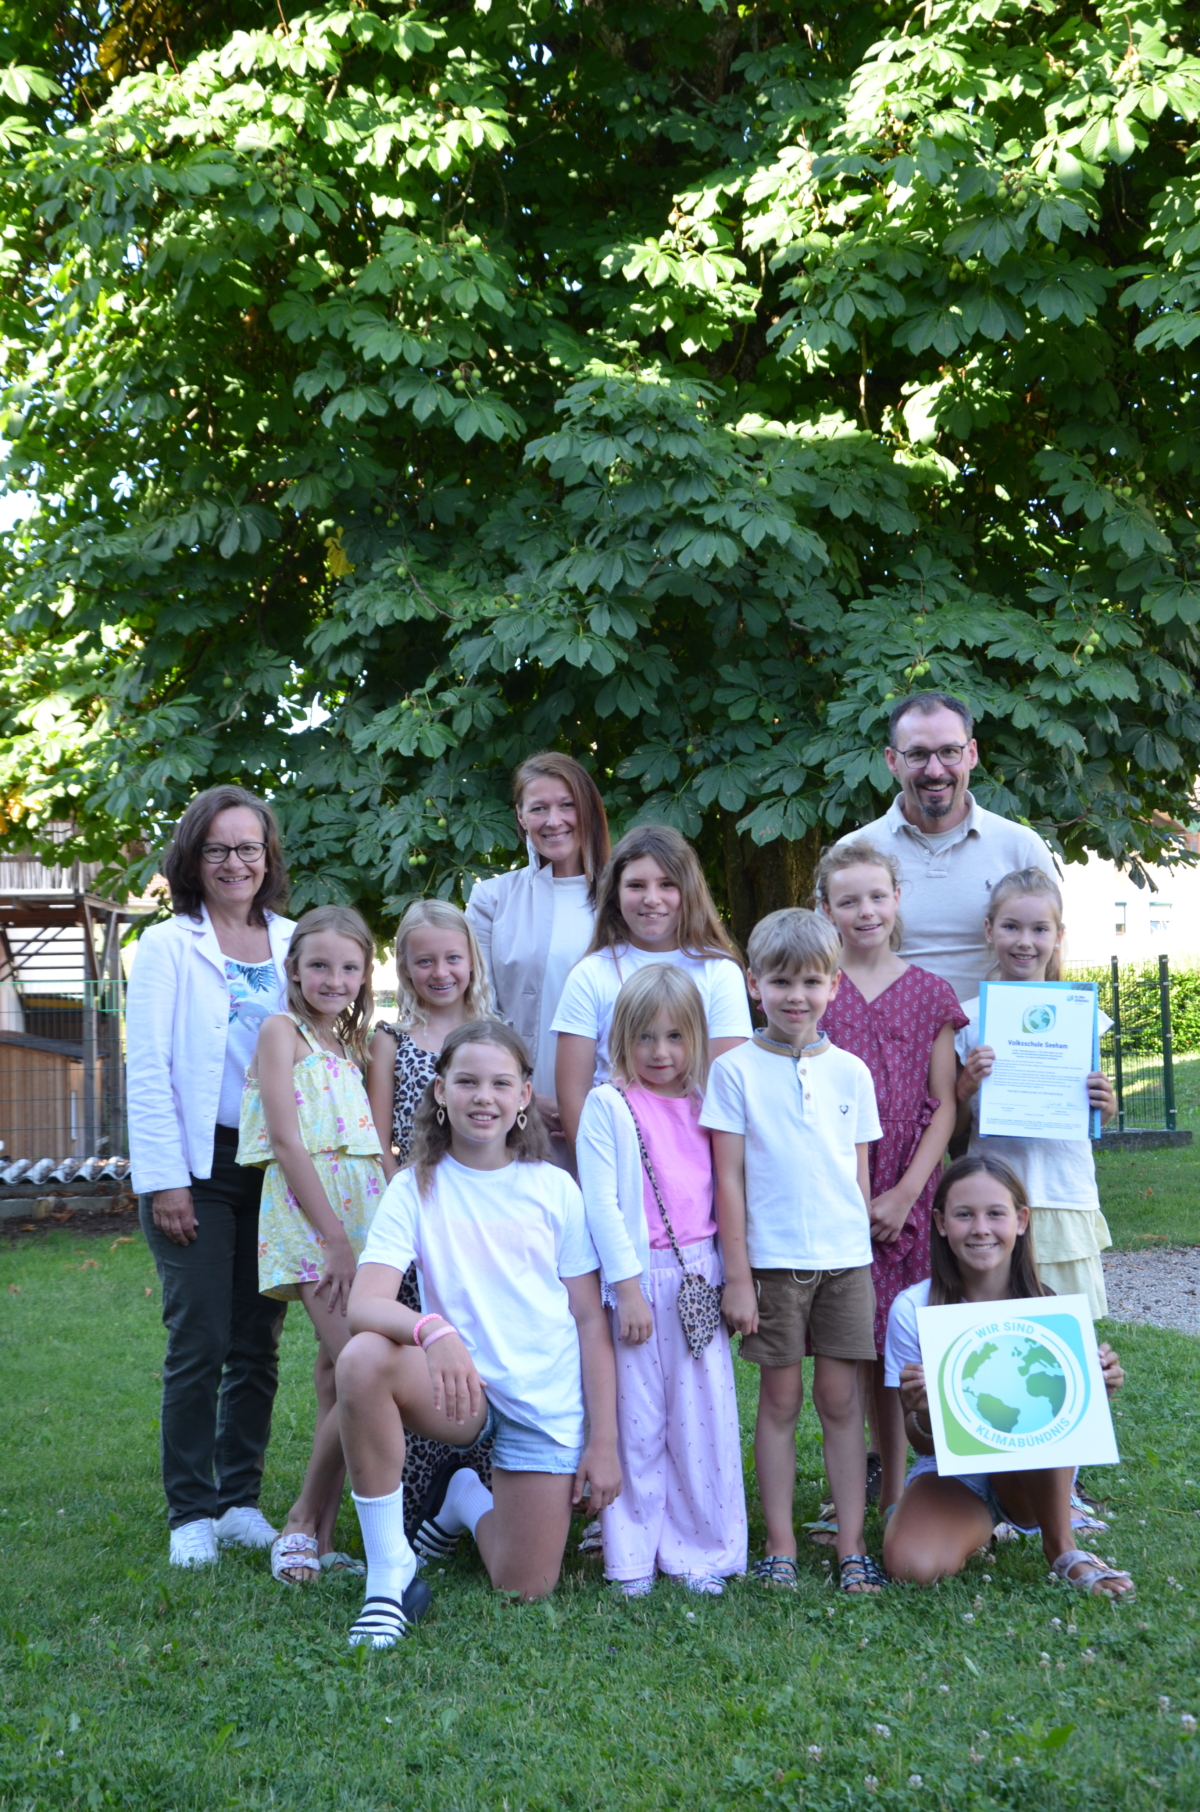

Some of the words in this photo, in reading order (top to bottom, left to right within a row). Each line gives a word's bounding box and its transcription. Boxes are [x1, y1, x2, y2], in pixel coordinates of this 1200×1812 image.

[1008, 1039, 1043, 1048] Volksschule
[1044, 1041, 1068, 1049] Seeham
[975, 1323, 999, 1338] WIR
[1003, 1321, 1034, 1335] SIND
[975, 1417, 1070, 1448] KLIMABÜNDNIS
